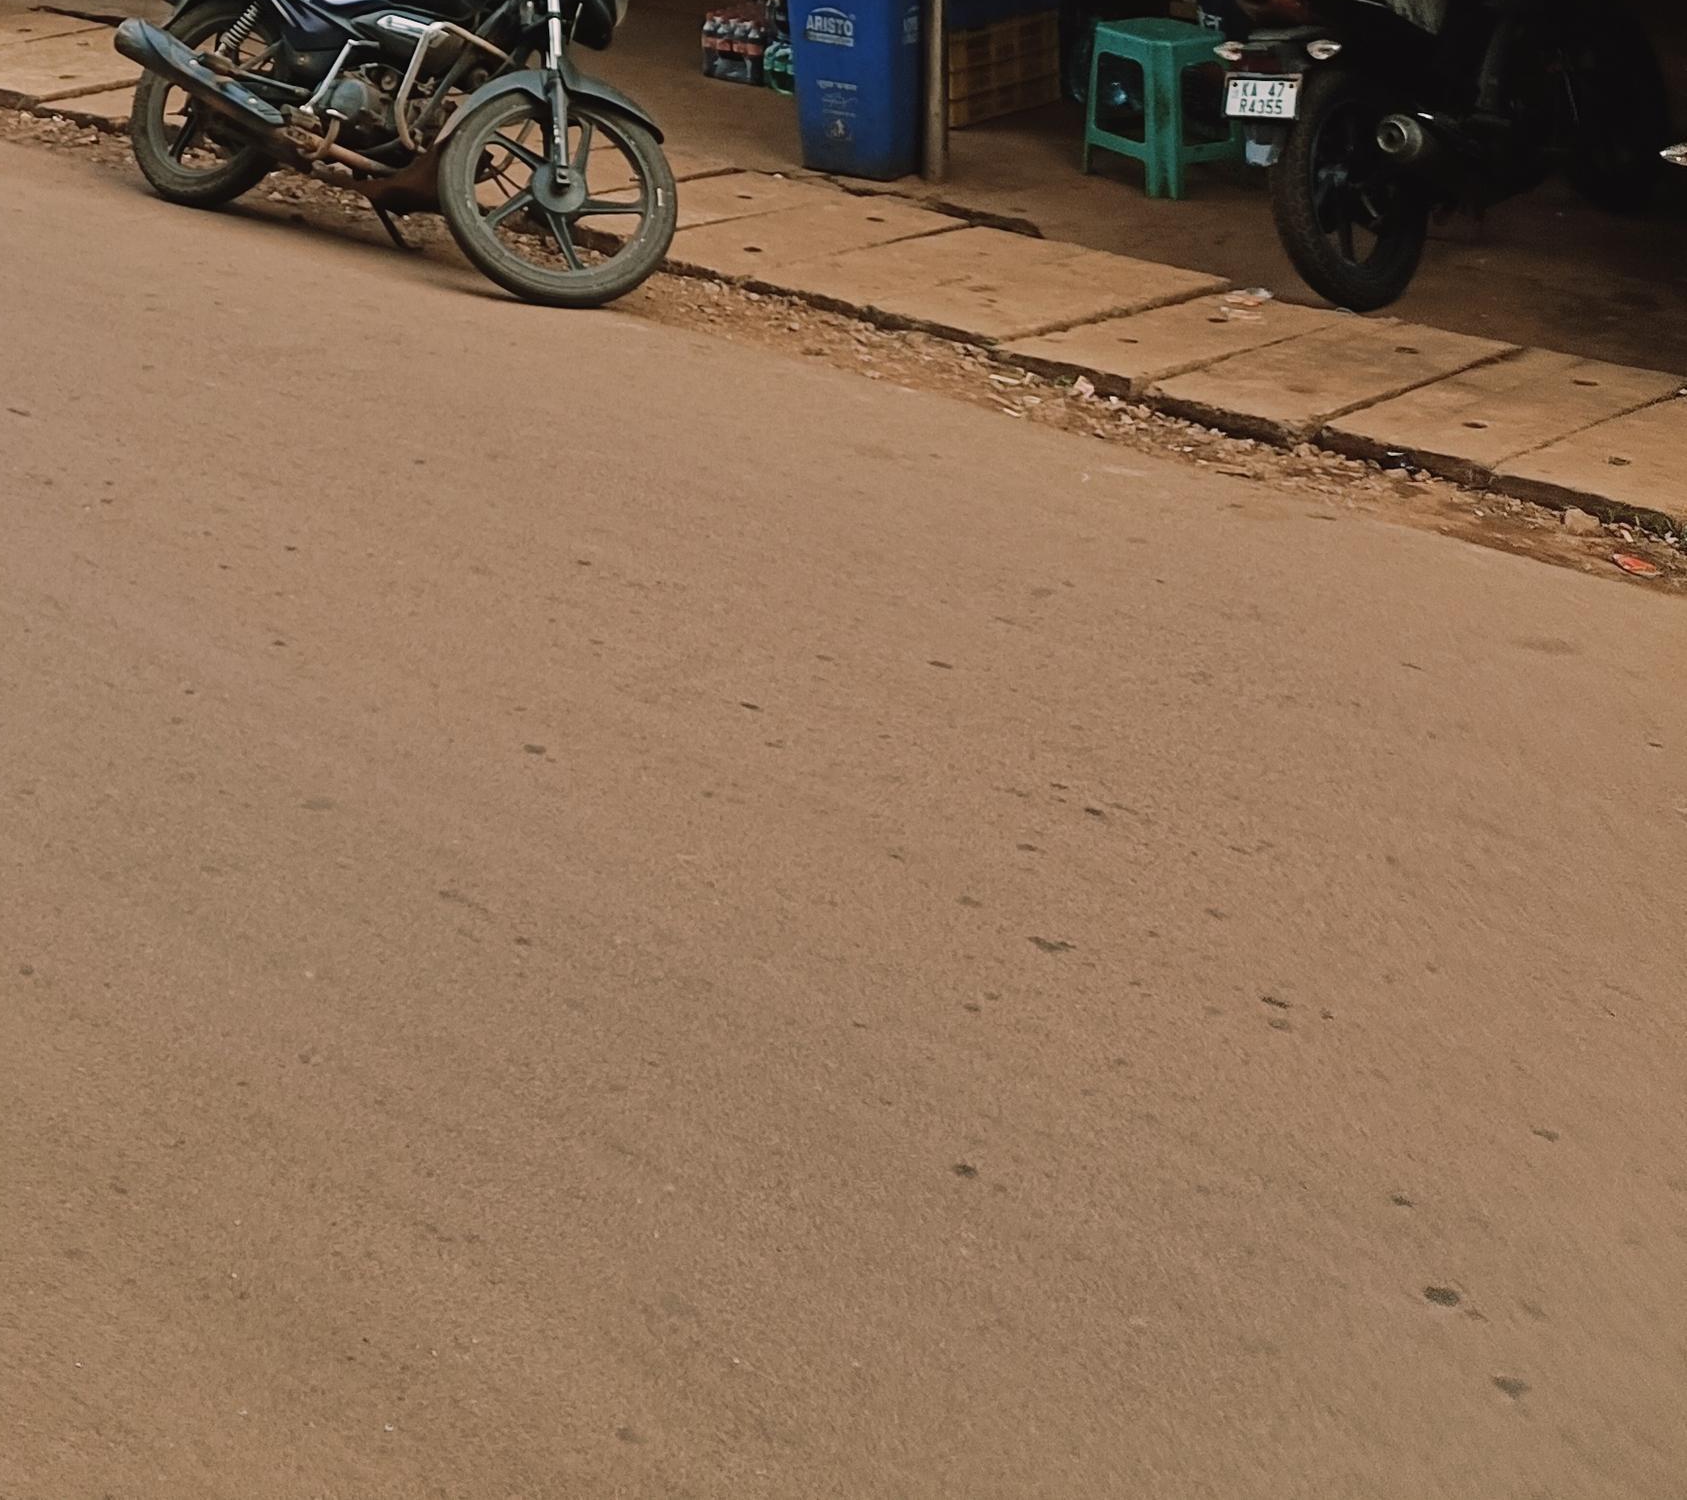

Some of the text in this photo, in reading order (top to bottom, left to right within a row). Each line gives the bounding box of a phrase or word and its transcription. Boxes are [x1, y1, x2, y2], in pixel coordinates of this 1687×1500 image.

[806, 14, 854, 36] ARISTO
[1241, 81, 1285, 98] KA 47
[1238, 98, 1283, 115] R4355
